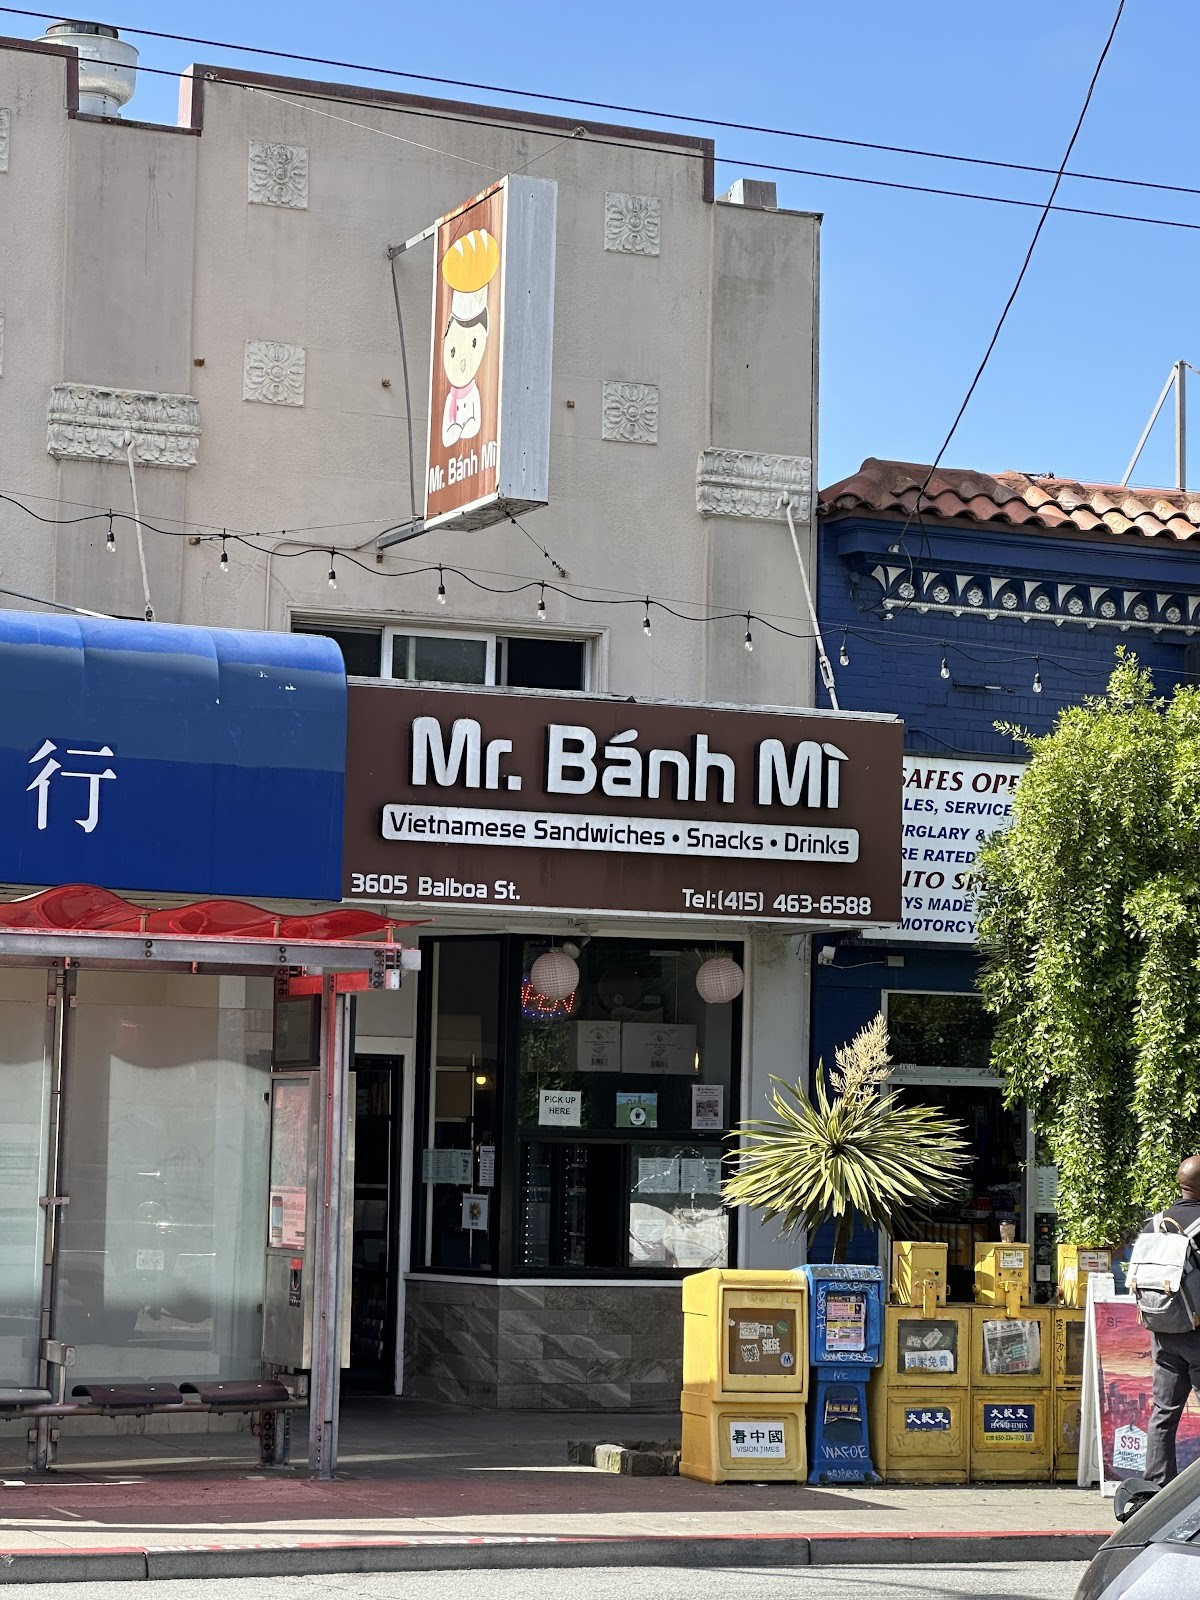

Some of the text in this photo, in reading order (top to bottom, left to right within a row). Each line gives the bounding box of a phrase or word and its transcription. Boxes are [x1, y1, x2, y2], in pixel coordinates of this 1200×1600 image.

[429, 465, 445, 494] Mr.
[448, 448, 478, 485] Bánh
[412, 716, 849, 809] Mr. Bánh Mì
[26, 739, 117, 832] 行
[390, 811, 849, 855] Vietnamese Sandwiches Snacks Drinks
[351, 873, 521, 900] 3605 Balboa St.
[773, 894, 872, 915] 463-6588
[928, 897, 973, 912] MADE
[545, 1095, 576, 1104] PICK UP
[549, 1107, 571, 1115] HERE
[732, 1429, 783, 1444] 看中國
[1120, 1435, 1141, 1450] $35
[736, 1445, 780, 1454] VISION TIMES
